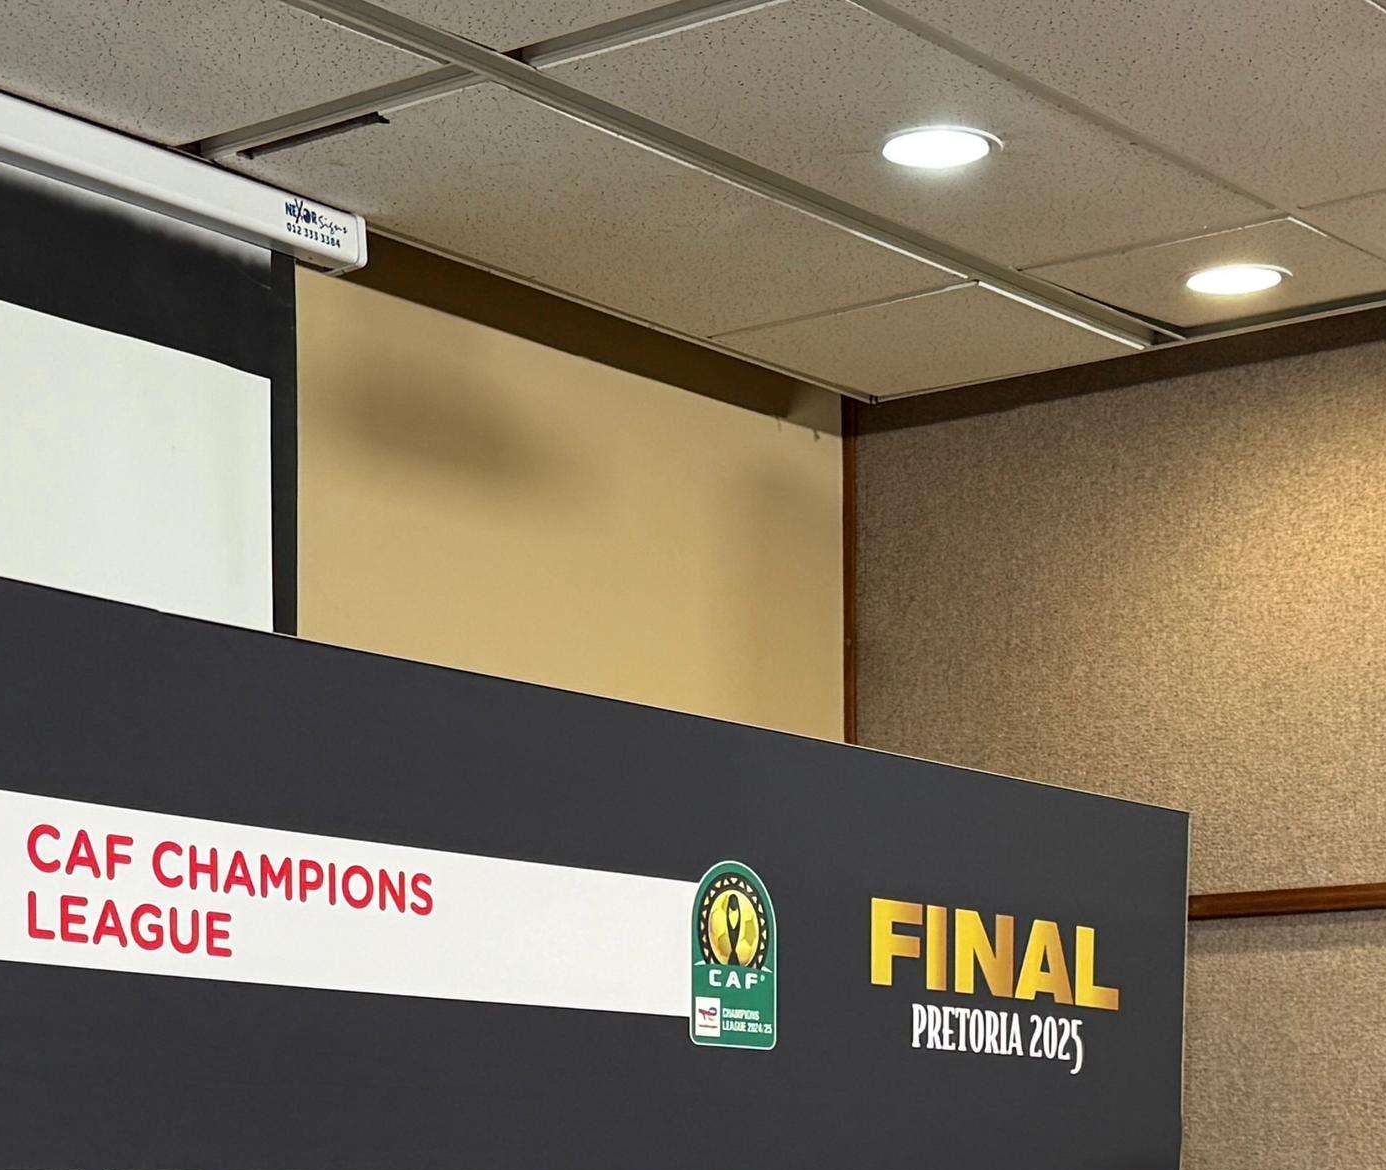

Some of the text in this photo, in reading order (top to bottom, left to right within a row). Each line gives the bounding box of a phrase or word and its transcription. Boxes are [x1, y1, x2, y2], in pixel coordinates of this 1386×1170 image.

[26, 823, 433, 917] CAF CHAMPIONS
[27, 890, 233, 958] LEAGUE
[870, 897, 1120, 1011] FINAL
[709, 969, 758, 989] CAF
[911, 1003, 1084, 1075] PRETORIA 2025
